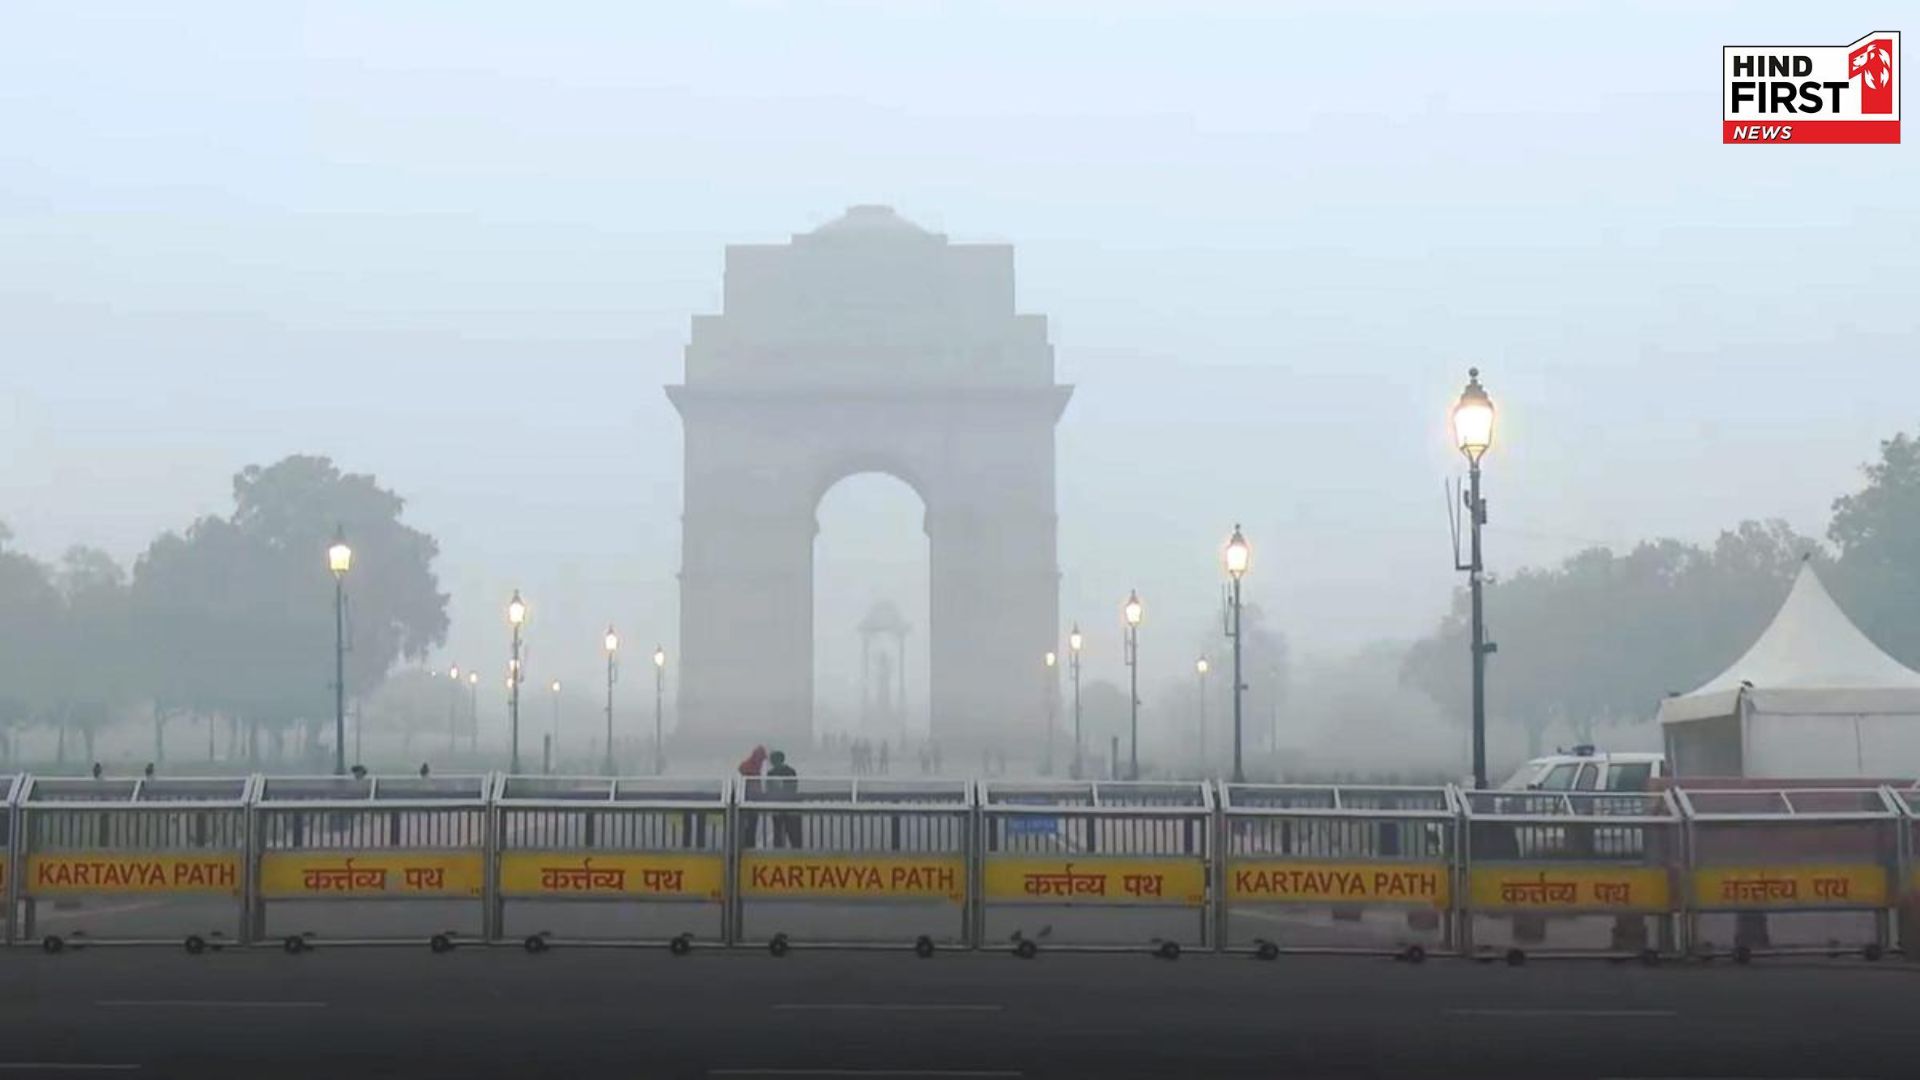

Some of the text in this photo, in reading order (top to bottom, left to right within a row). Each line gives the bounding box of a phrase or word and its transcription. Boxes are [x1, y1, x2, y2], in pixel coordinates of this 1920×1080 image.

[38, 863, 236, 886] KARTAVYA PATH
[406, 868, 445, 889] पथ
[643, 870, 683, 891] पथ
[752, 865, 955, 890] KARTAVYA PATH
[1123, 875, 1163, 896] पथ
[1236, 870, 1437, 896] KARTAVYA PATH
